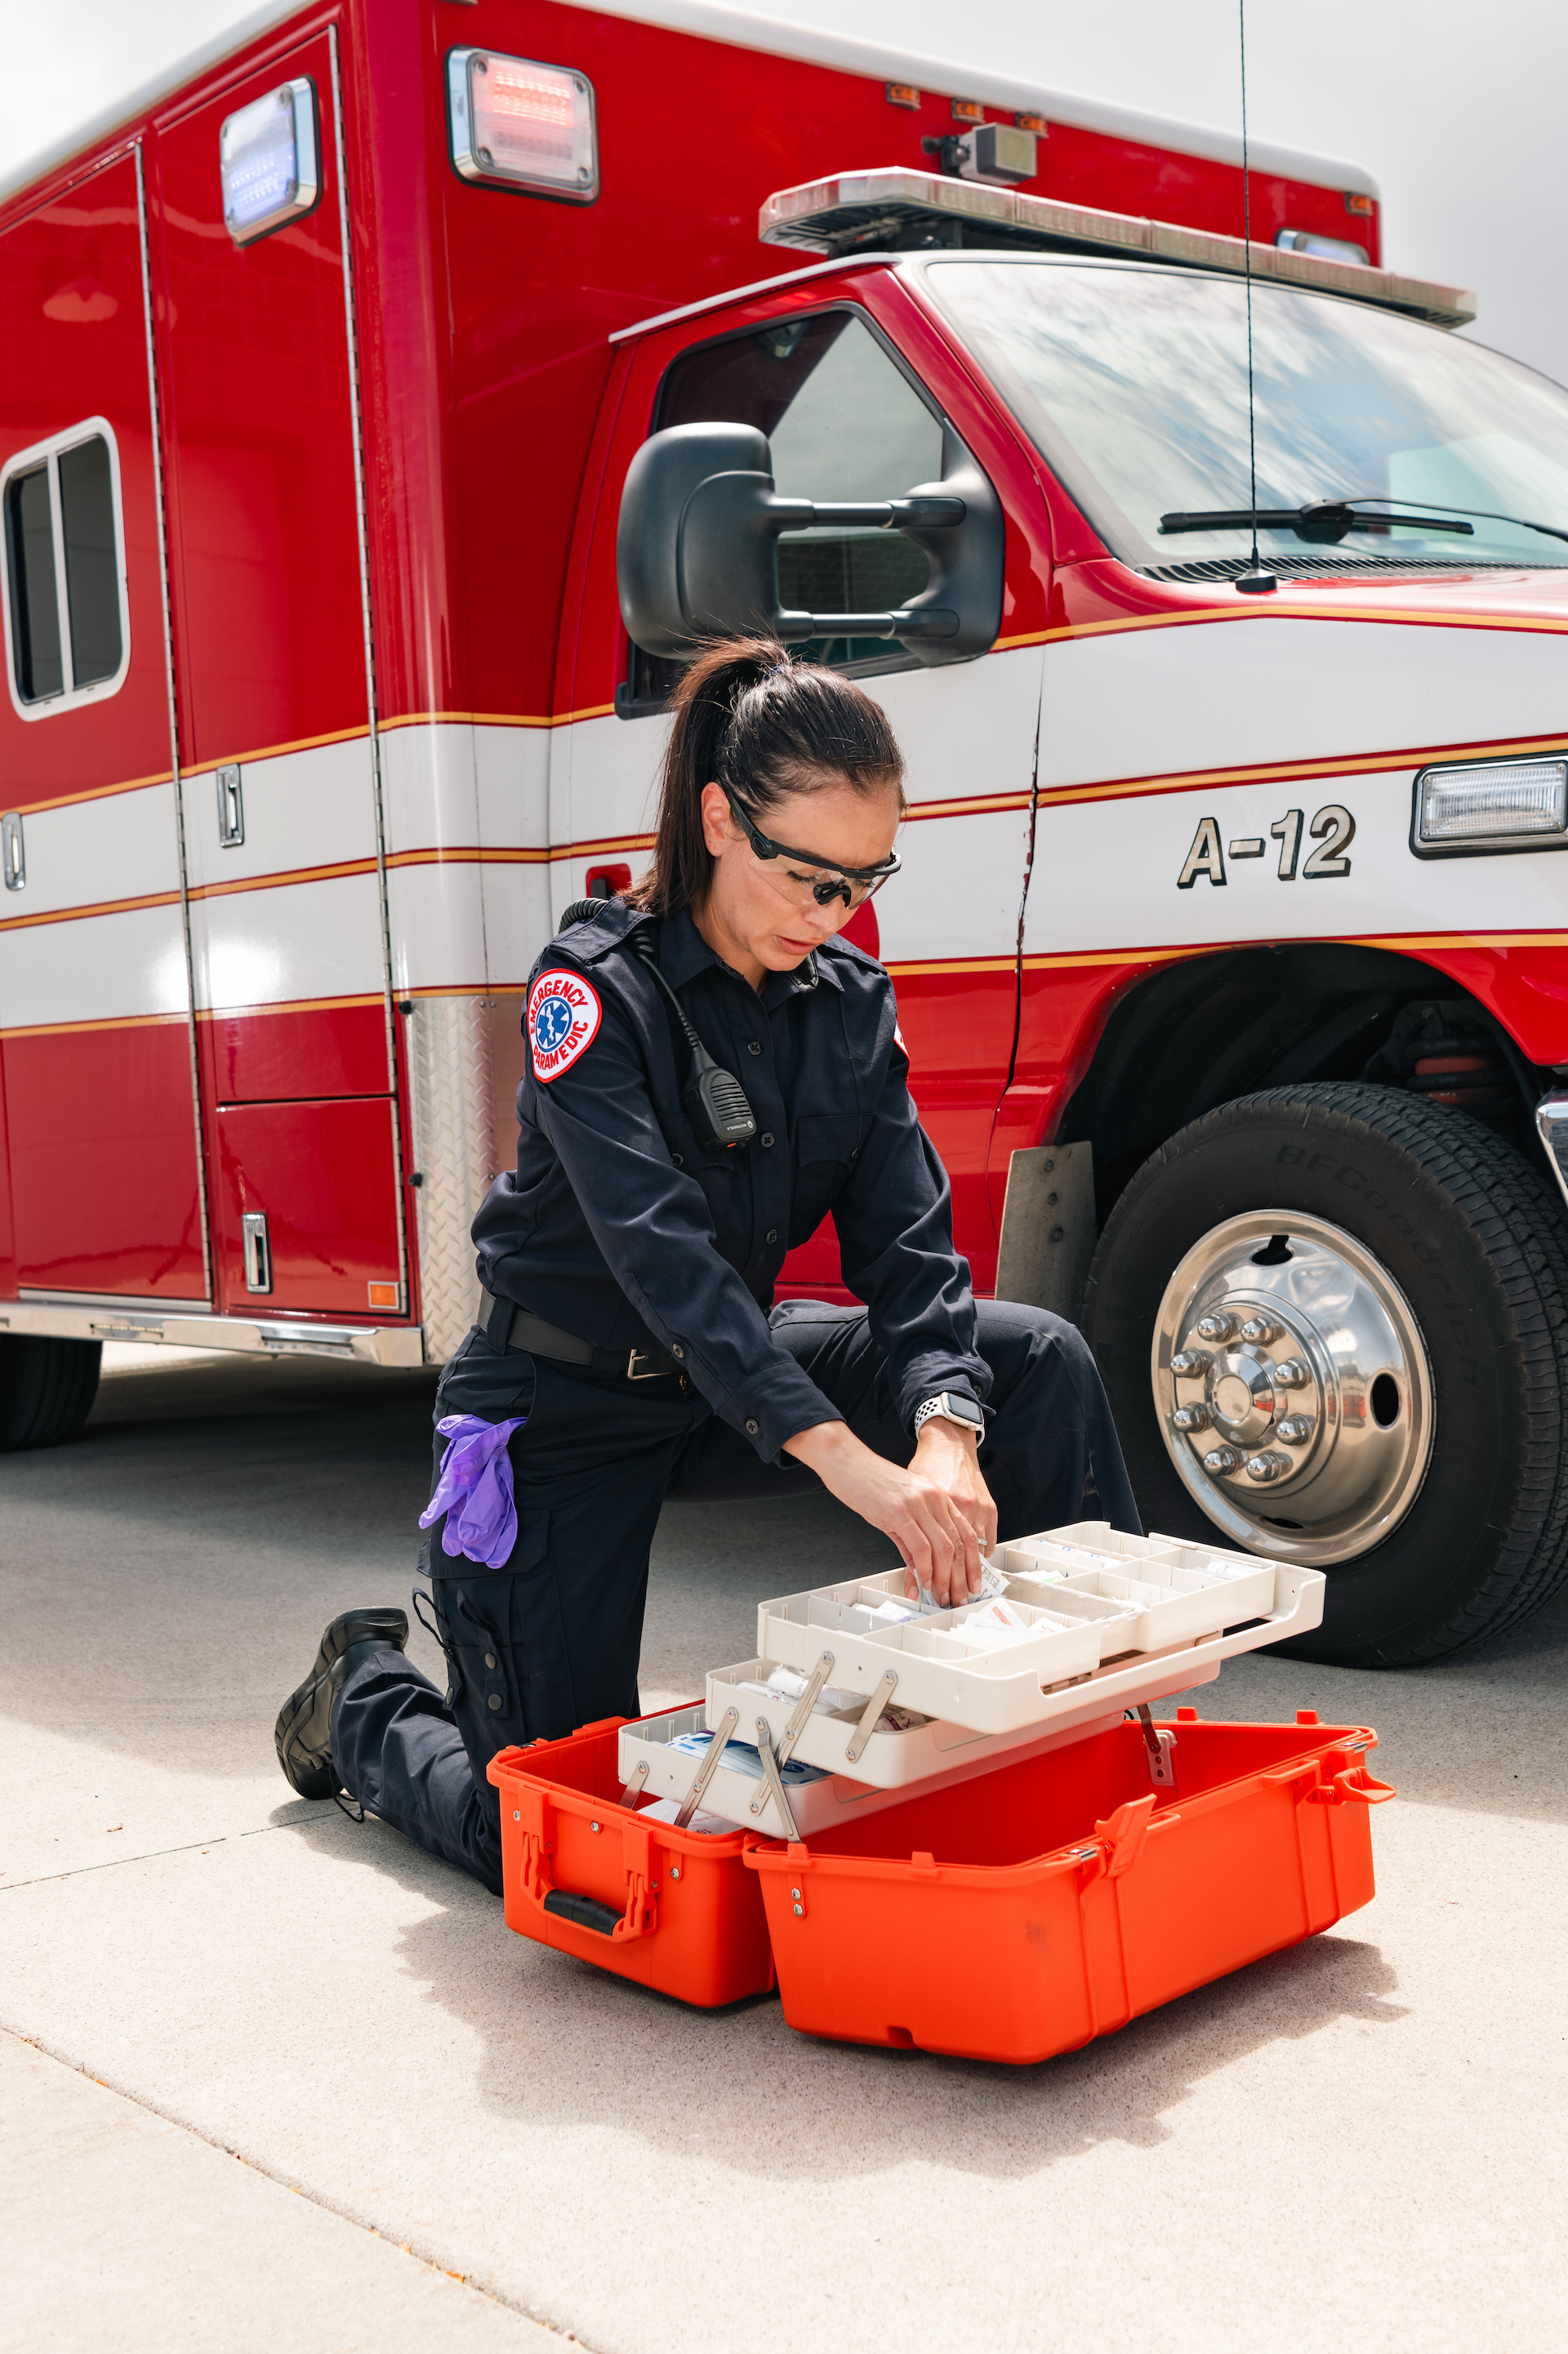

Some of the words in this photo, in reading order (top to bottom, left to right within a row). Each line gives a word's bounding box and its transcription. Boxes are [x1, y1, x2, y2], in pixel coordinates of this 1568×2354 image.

[1177, 804, 1356, 889] A-12
[530, 979, 588, 1035] EMERGENCY
[533, 1020, 588, 1071] PARAMEDIC
[727, 1123, 747, 1131] MOTOROLA
